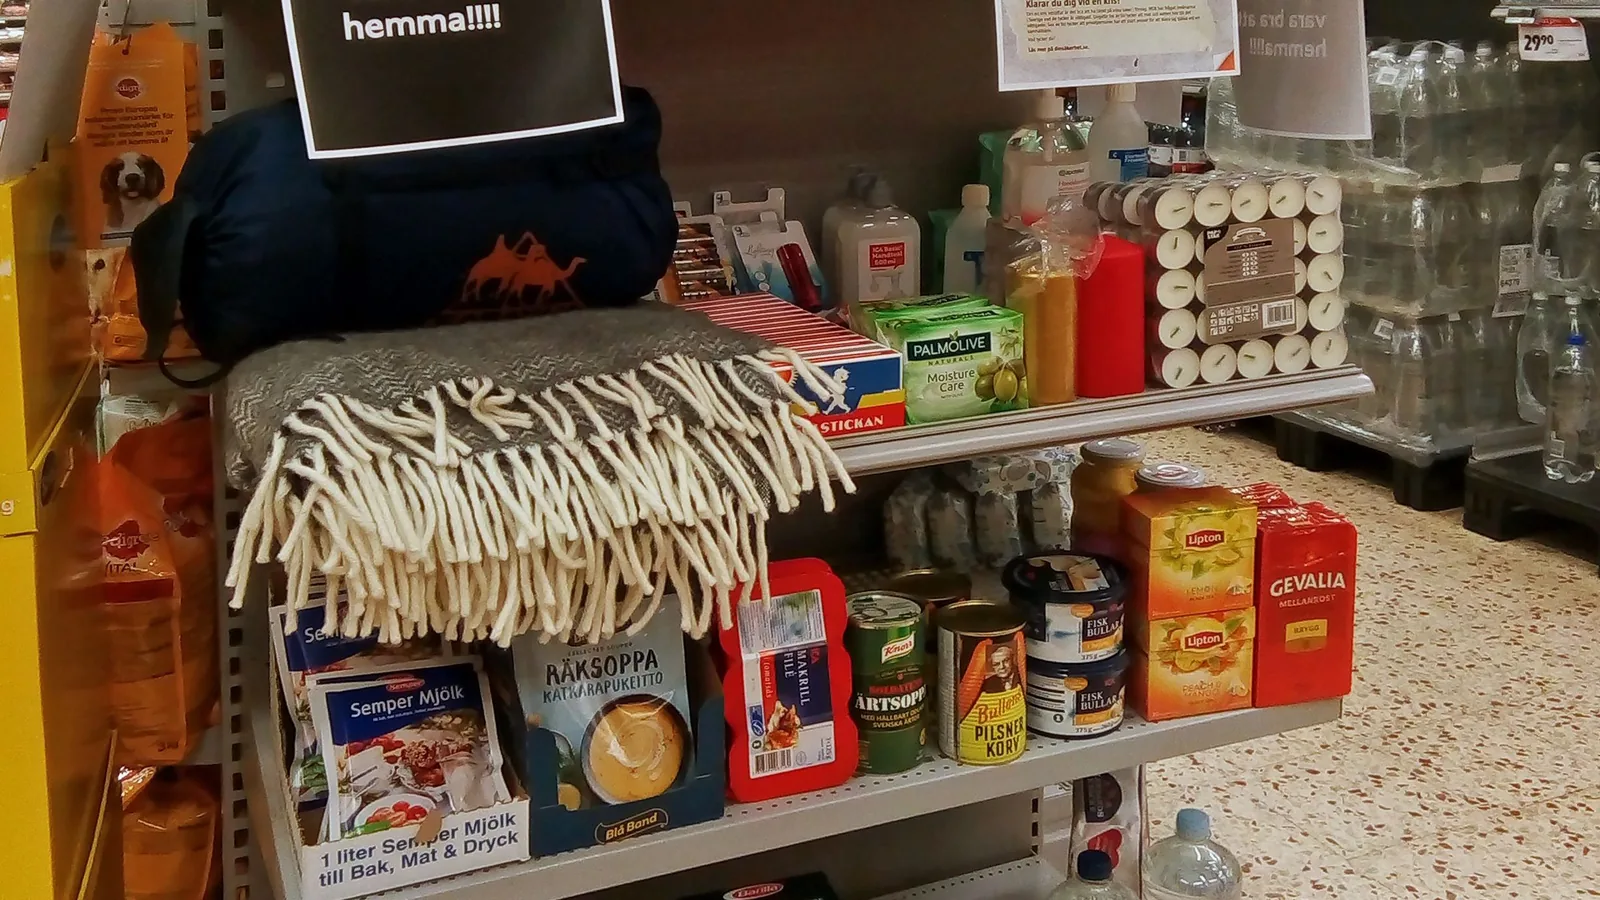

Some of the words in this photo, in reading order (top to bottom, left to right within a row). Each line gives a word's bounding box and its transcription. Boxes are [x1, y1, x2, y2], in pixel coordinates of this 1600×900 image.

[1026, 0, 1049, 8] Klarar
[1064, 0, 1076, 8] dig
[342, 3, 501, 41] hemma!!!!
[914, 336, 985, 357] PALMOLIVE
[928, 355, 975, 366] NATURALS
[927, 369, 975, 383] Moisture
[939, 382, 965, 393] Care
[815, 415, 884, 433] STICKAN
[1188, 534, 1222, 546] Lipton
[1269, 571, 1346, 598] GEVALIA
[1278, 594, 1337, 608] MELLANROST
[1087, 617, 1108, 629] FISK
[1293, 624, 1319, 634] BRYGG
[883, 640, 913, 657] Knorr
[1188, 635, 1221, 647] Lipton
[546, 649, 659, 686] RÄKSOPPA
[783, 652, 798, 678] FILÉ
[796, 650, 811, 706] MAKRILL
[543, 671, 663, 704] KATKARAPUKEITTO
[1081, 691, 1104, 702] FISK
[351, 694, 414, 718] Semper
[419, 685, 465, 706] Mjölk
[873, 720, 903, 729] SVENSKA
[975, 716, 1024, 742] PILSNER
[986, 735, 1020, 758] KORV
[605, 823, 625, 841] Blå
[626, 812, 658, 833] Band
[321, 853, 329, 867] 1
[337, 845, 376, 865] liter
[465, 812, 516, 836] Mjölk
[320, 868, 343, 887] till
[351, 861, 394, 880] Bak,
[402, 849, 438, 869] Mat
[444, 843, 458, 859] &
[464, 831, 519, 855] Dryck
[737, 885, 779, 898] Barilla
